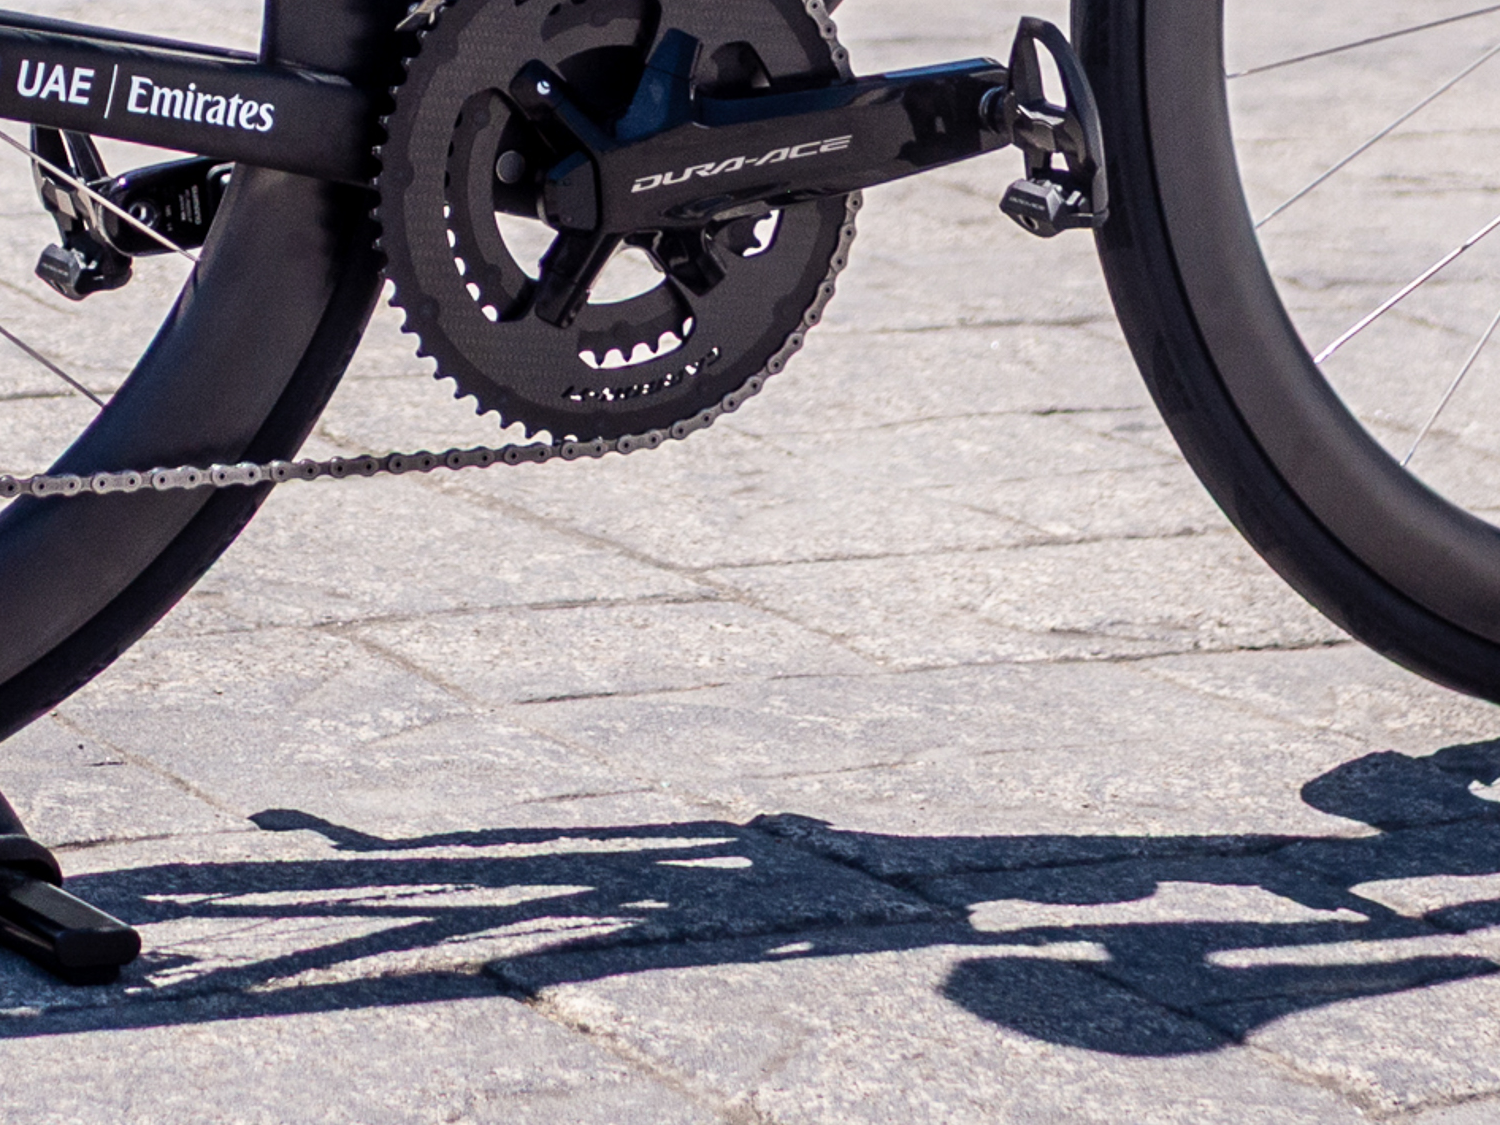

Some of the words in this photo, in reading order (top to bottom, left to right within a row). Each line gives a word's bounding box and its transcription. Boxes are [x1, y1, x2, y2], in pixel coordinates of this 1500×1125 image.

[16, 59, 95, 105] UAE
[126, 75, 275, 133] Emirates
[631, 134, 853, 194] DURA-ACE
